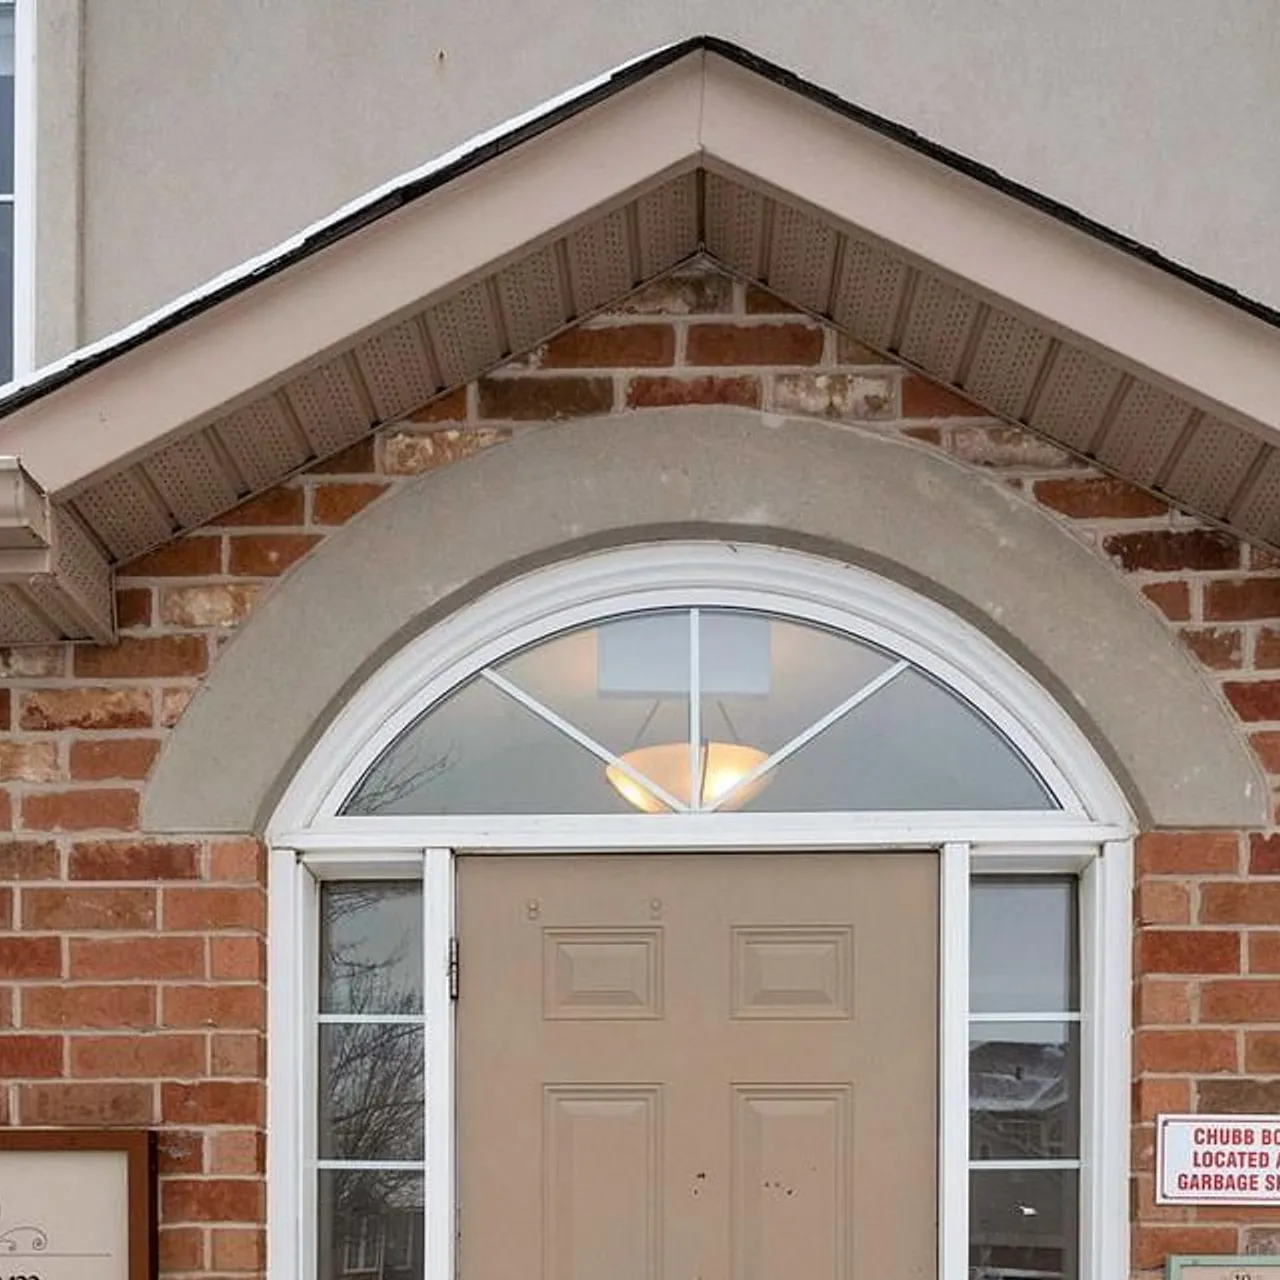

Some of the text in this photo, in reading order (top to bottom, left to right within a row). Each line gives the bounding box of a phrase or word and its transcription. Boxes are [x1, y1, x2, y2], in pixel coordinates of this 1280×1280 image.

[1193, 1127, 1255, 1145] CHUBB
[1192, 1151, 1269, 1169] LOCATED
[1177, 1174, 1259, 1191] GARBAGE
